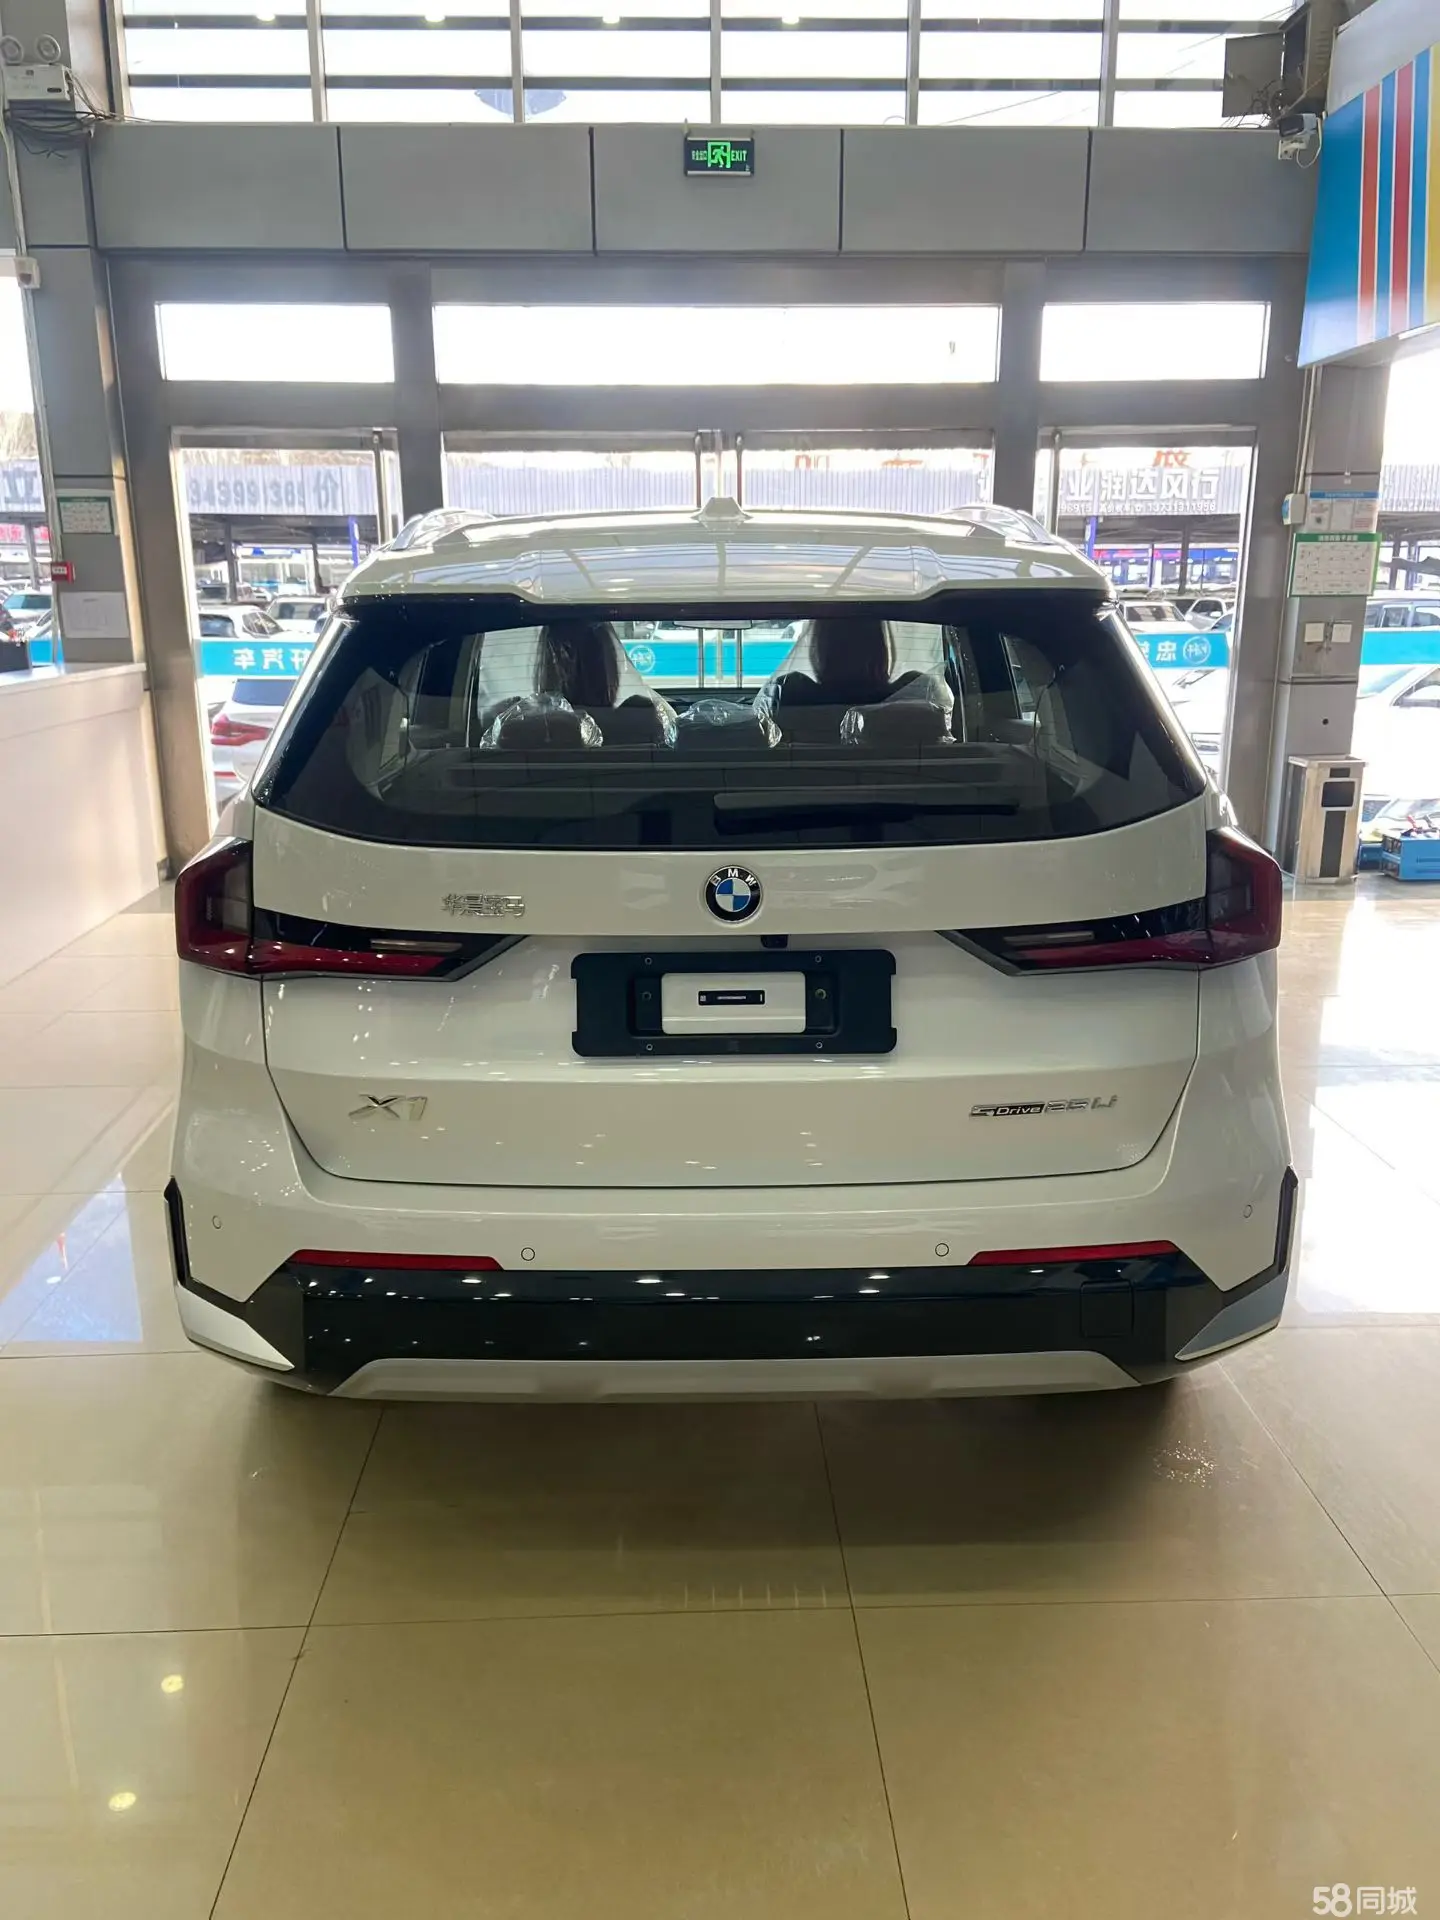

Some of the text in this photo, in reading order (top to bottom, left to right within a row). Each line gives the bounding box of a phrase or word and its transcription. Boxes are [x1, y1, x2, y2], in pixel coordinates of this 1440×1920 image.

[731, 149, 747, 162] EXIT
[1100, 468, 1218, 502] 润达风行
[710, 868, 757, 887] BMW
[441, 893, 526, 917] 华晨宝马
[348, 1093, 428, 1121] X1
